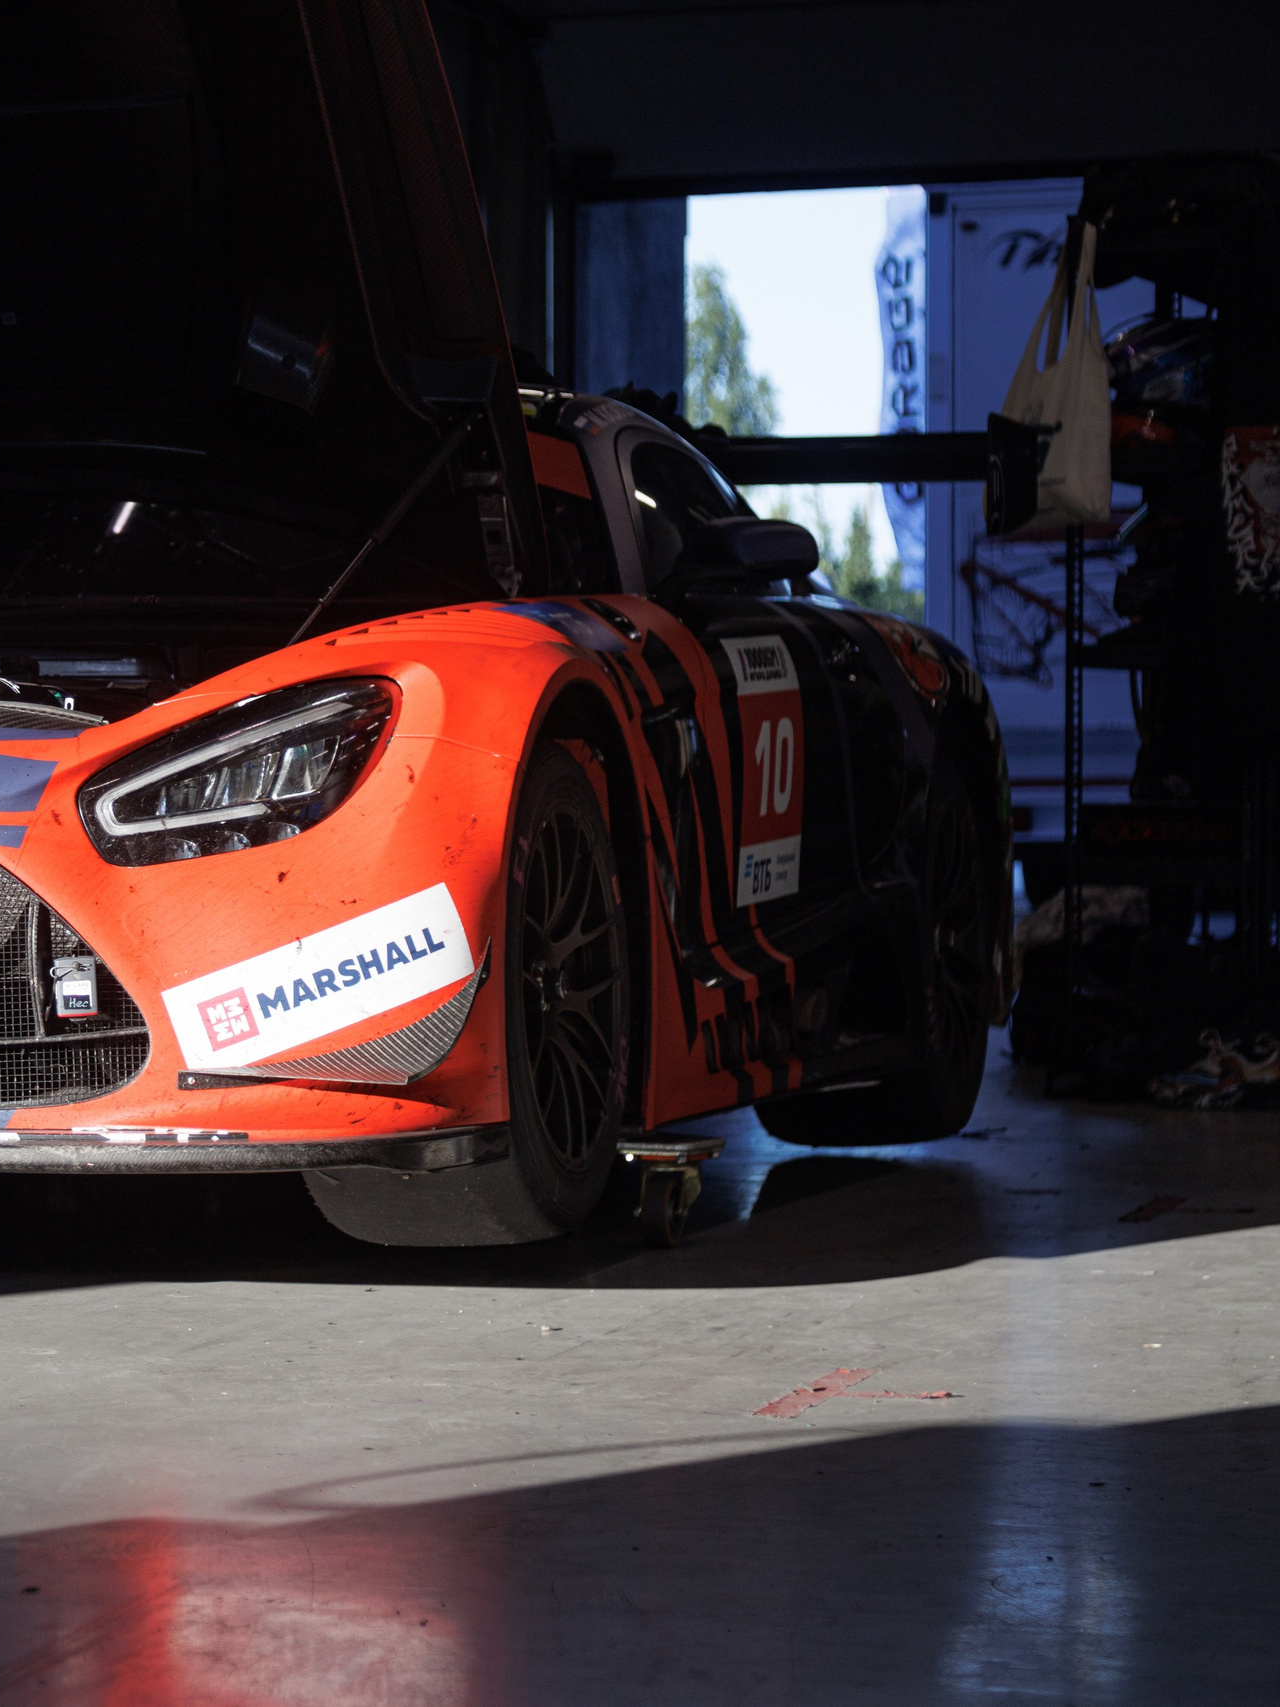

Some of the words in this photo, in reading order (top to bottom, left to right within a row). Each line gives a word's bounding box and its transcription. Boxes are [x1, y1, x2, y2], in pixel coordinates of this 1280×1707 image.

[755, 717, 794, 817] 10
[752, 858, 772, 894] ВТБ
[256, 927, 446, 1020] MARSHALL
